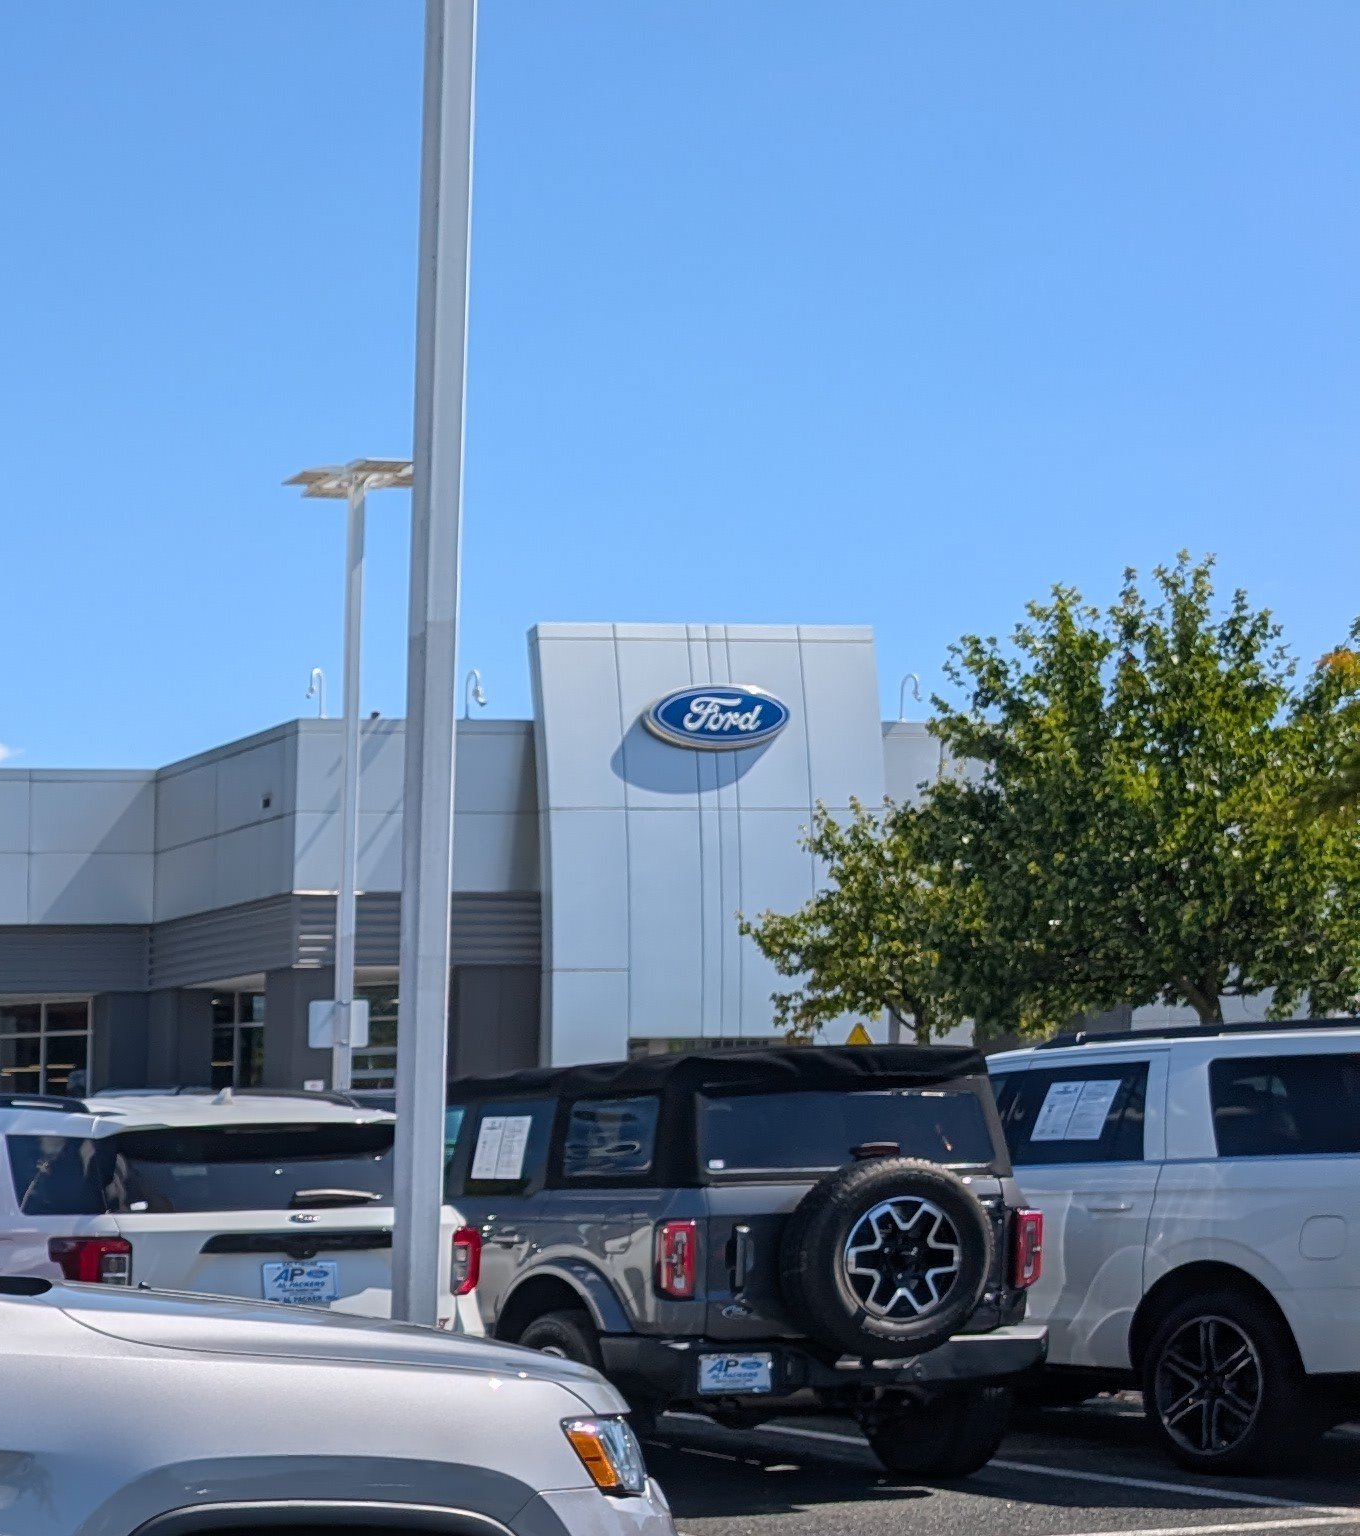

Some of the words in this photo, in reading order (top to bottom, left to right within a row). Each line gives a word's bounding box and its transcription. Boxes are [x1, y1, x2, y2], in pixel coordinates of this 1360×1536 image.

[683, 696, 763, 732] Ford
[273, 1268, 305, 1282] AP
[707, 1359, 739, 1373] AP
